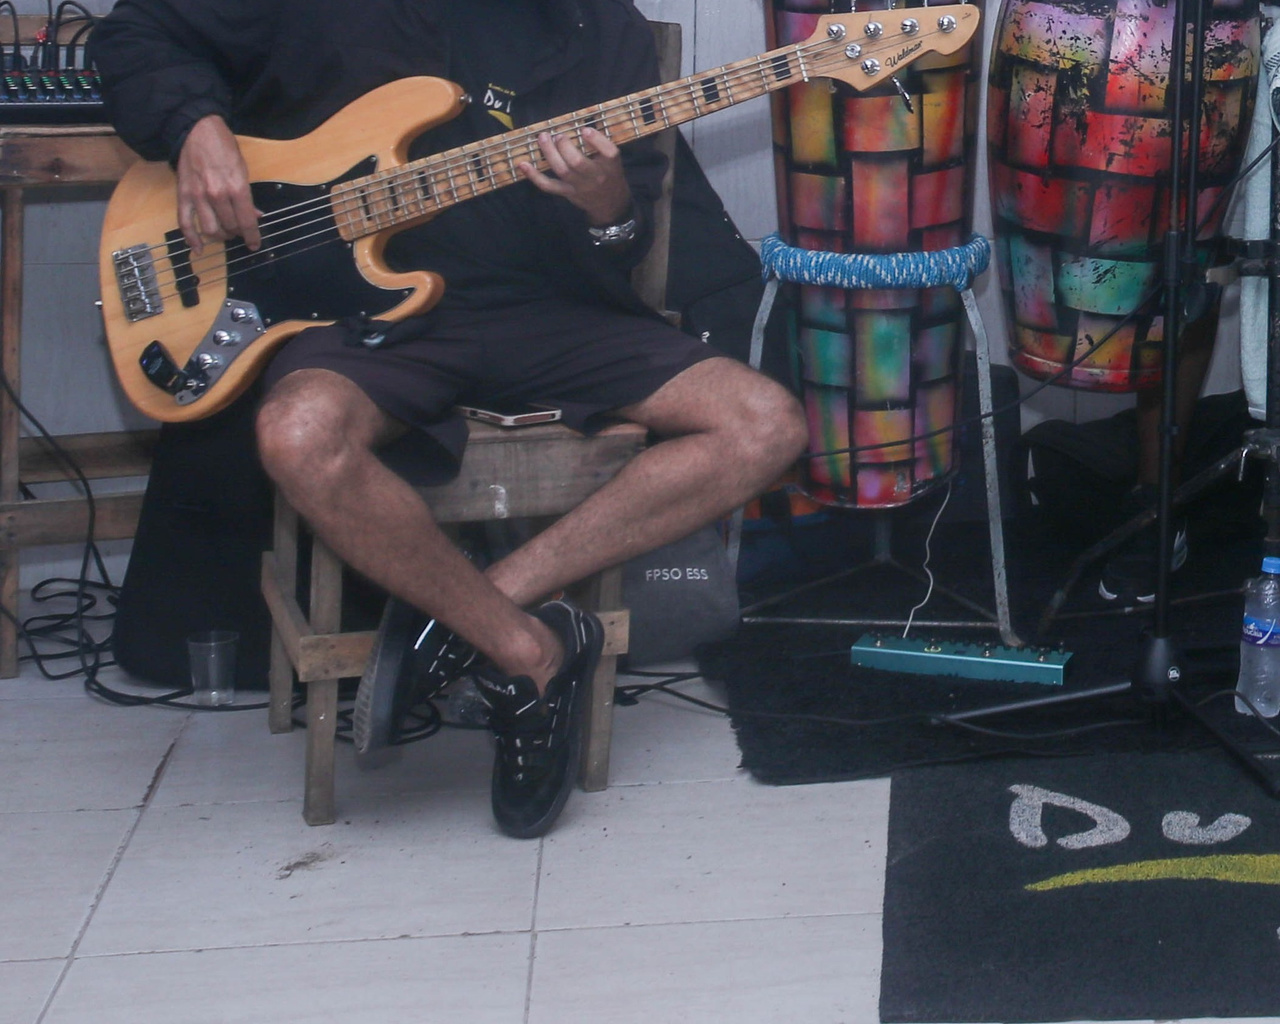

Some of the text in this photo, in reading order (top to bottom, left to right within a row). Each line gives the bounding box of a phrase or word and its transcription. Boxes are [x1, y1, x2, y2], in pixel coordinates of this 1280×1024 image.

[645, 567, 709, 581] FPSO ESS
[1008, 784, 1252, 849] Du
